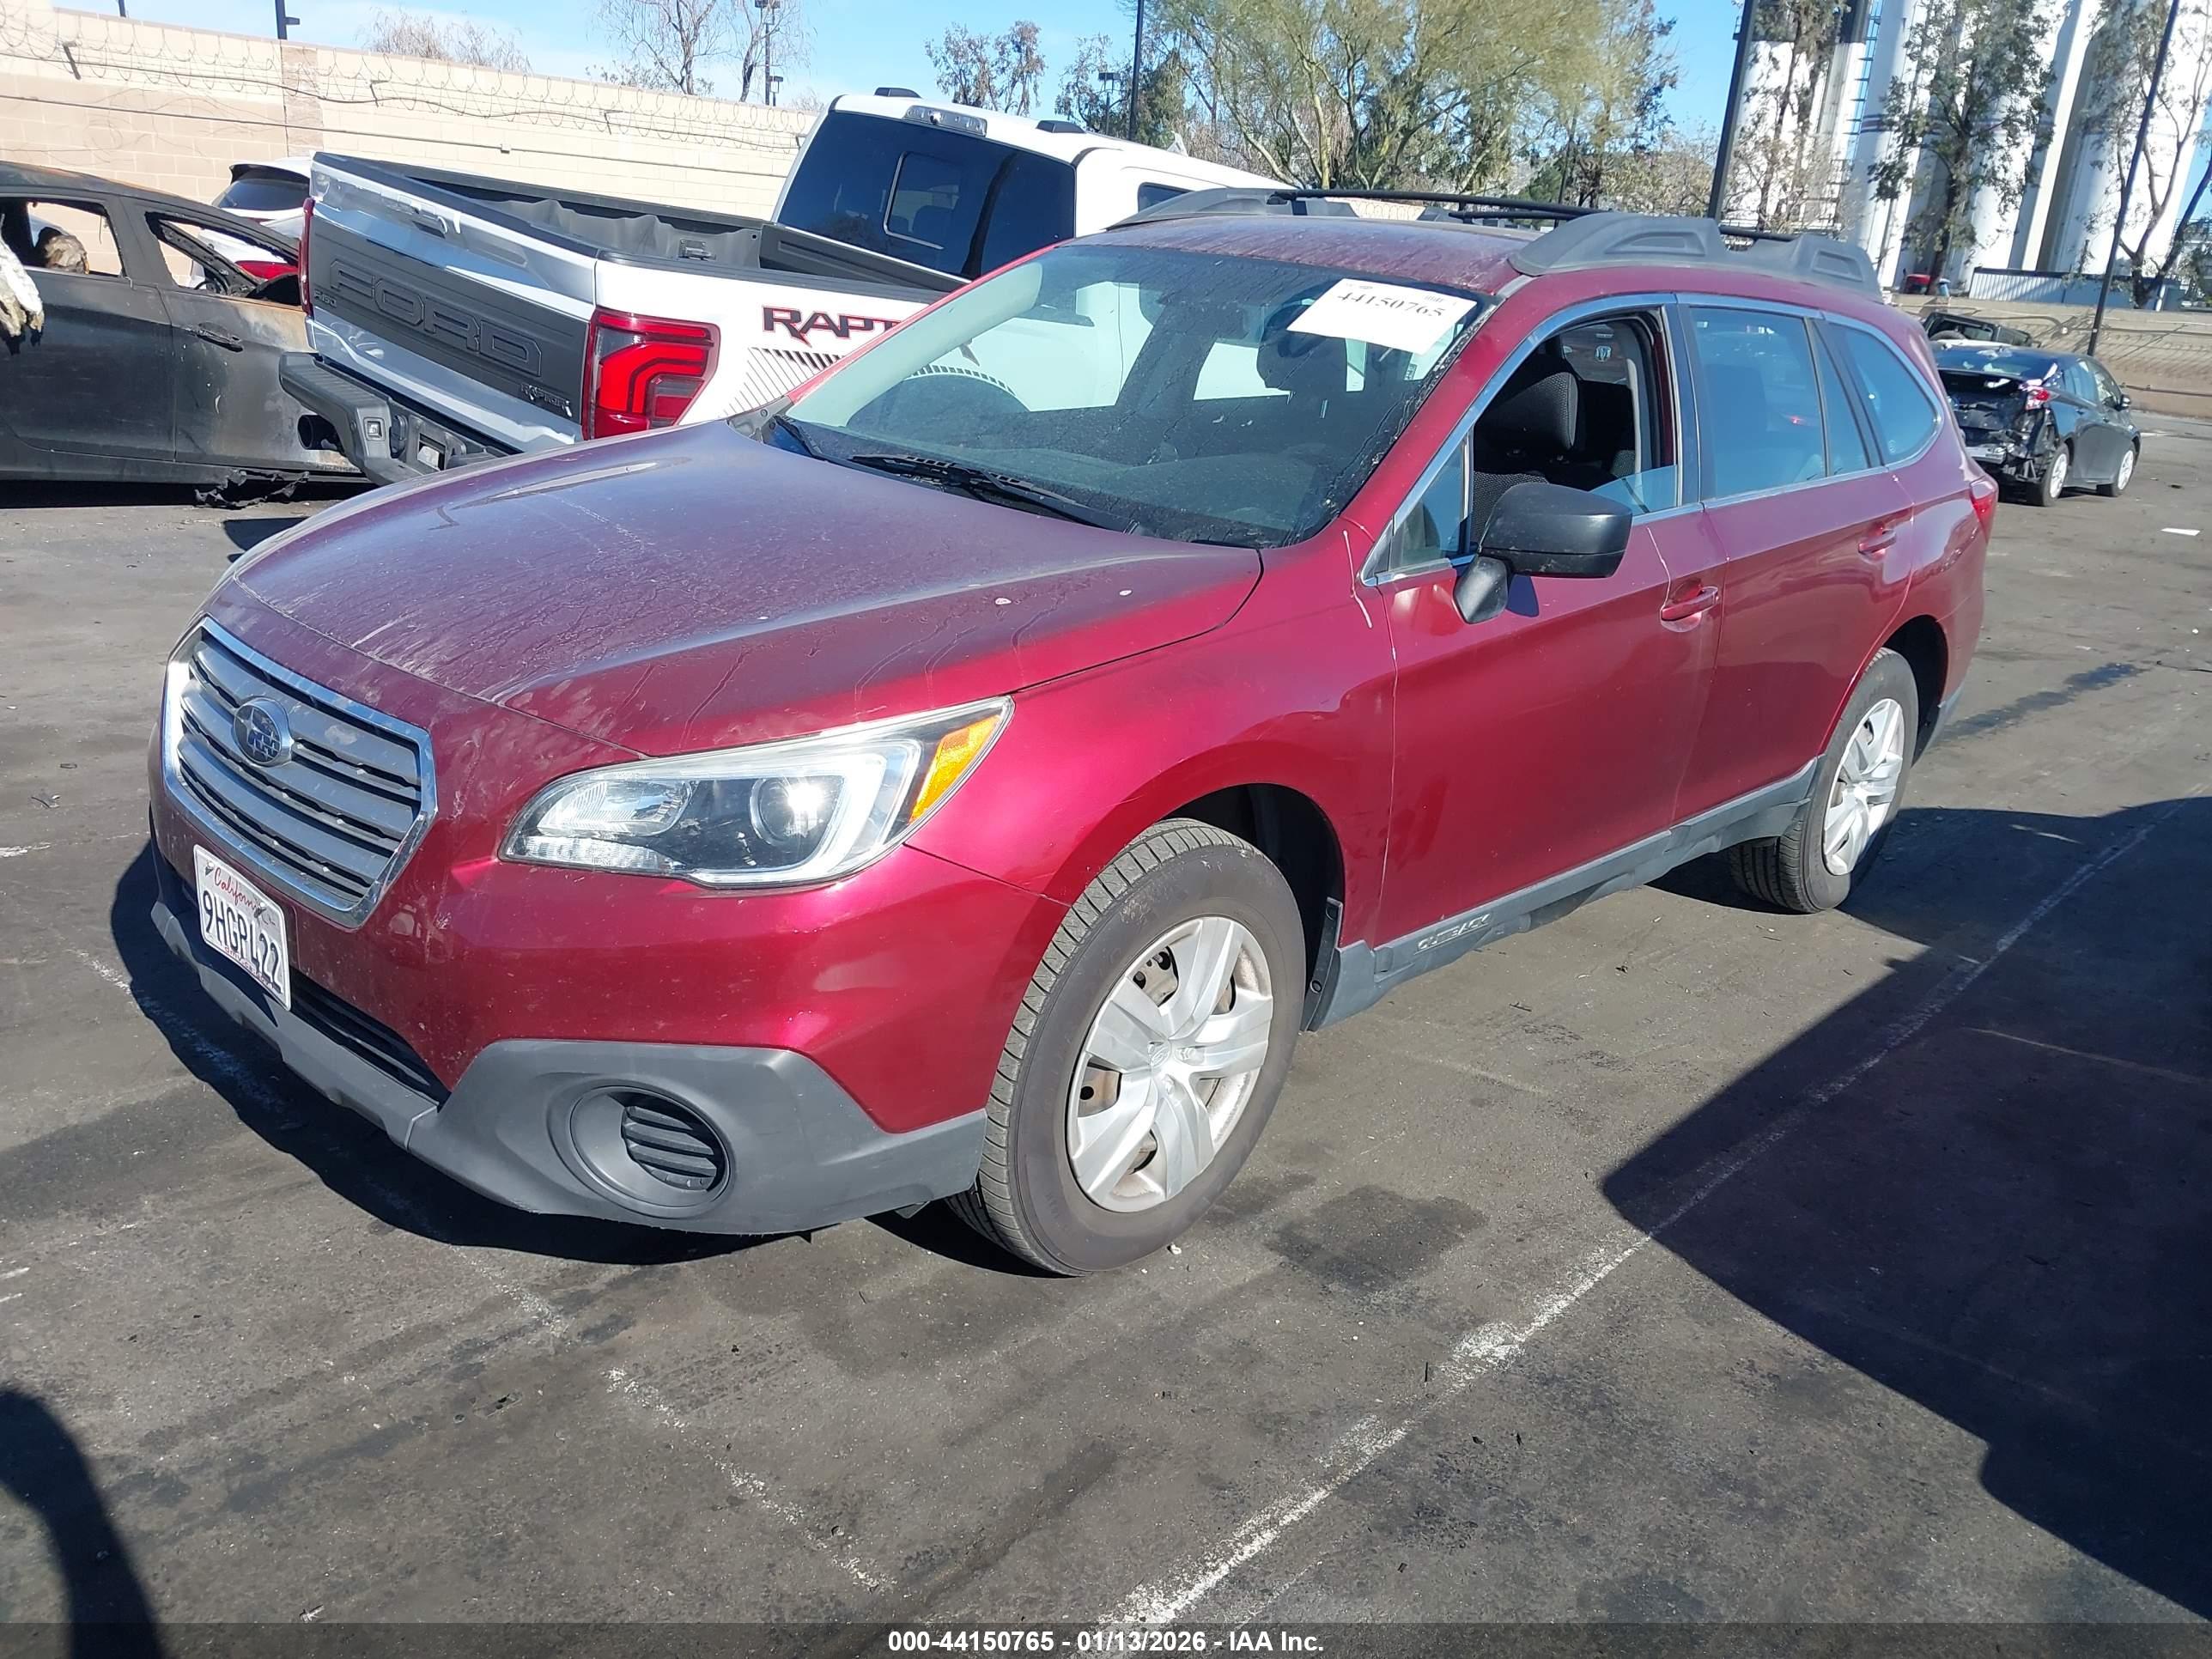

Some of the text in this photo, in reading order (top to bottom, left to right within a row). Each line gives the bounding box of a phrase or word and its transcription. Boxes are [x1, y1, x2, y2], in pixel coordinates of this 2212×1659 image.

[330, 259, 542, 377] FORD
[1338, 292, 1445, 317] 44150765
[520, 383, 573, 417] RAPTOR
[203, 890, 283, 994] 9HGP422
